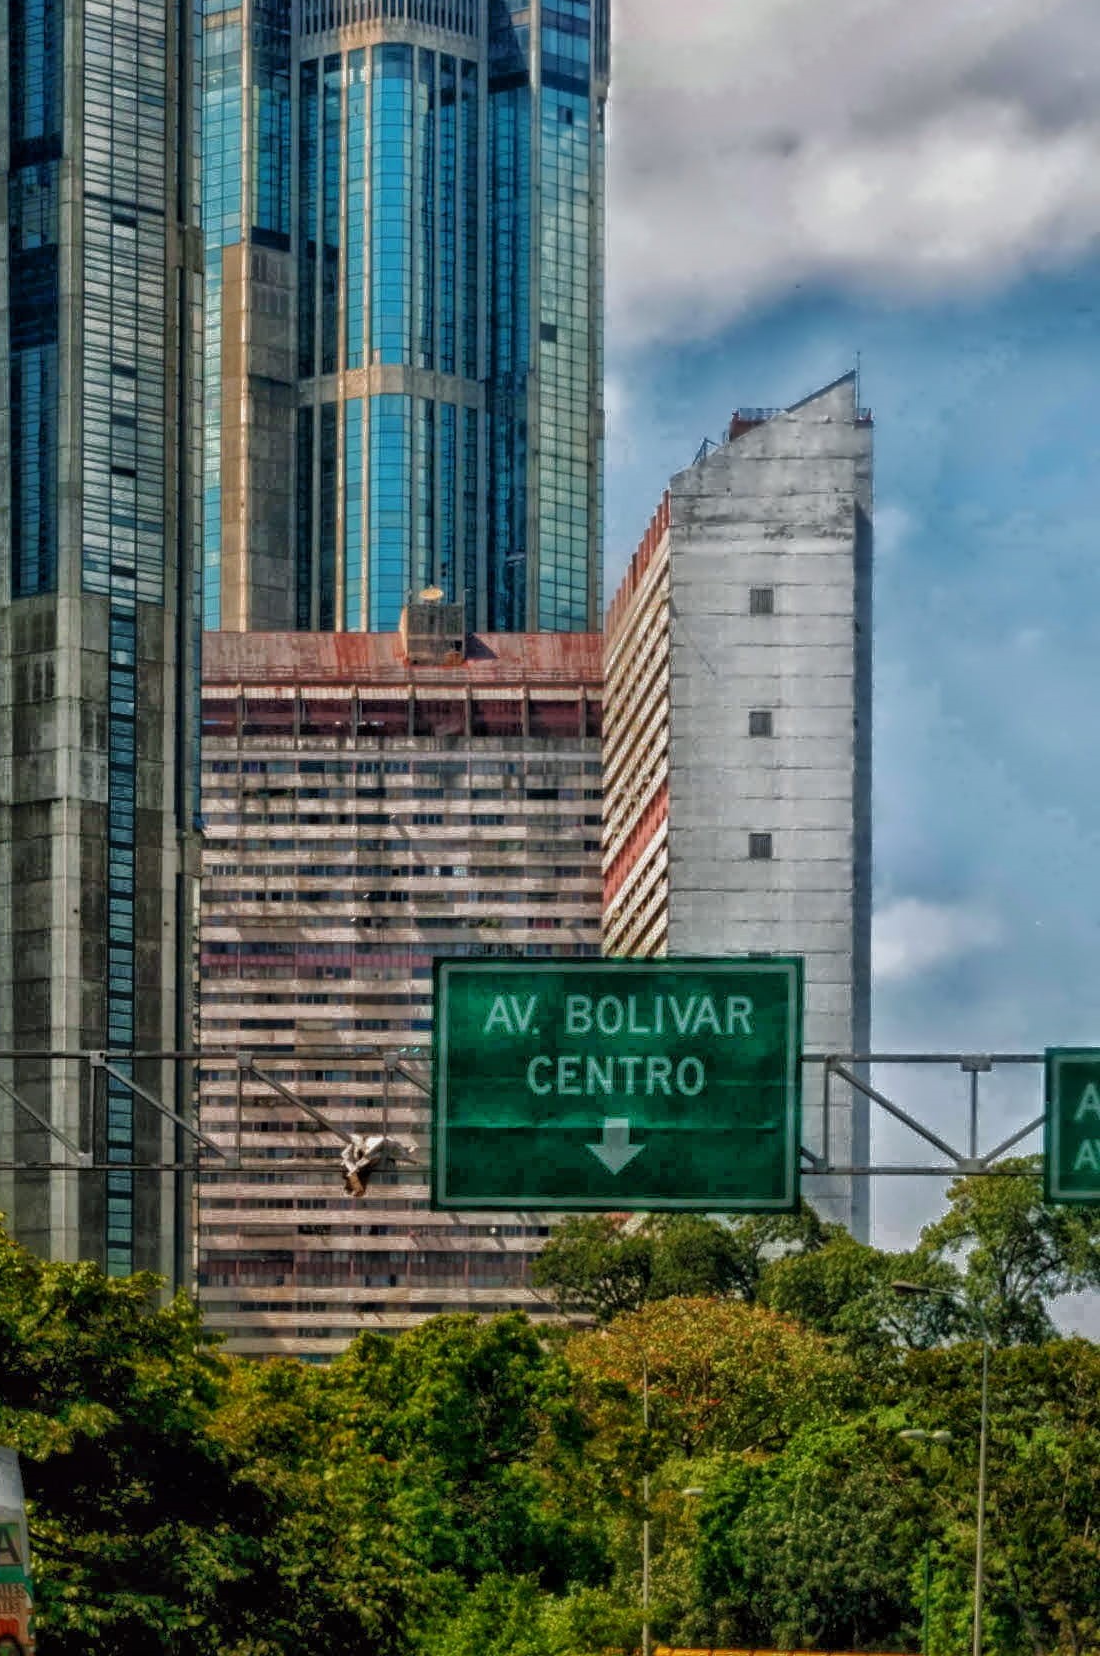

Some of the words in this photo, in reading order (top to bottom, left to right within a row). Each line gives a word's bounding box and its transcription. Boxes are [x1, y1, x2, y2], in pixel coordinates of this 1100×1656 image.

[483, 994, 540, 1034] AV.
[565, 994, 755, 1034] BOLIVAR
[526, 1055, 706, 1096] CENTRO
[1073, 1138, 1100, 1171] A
